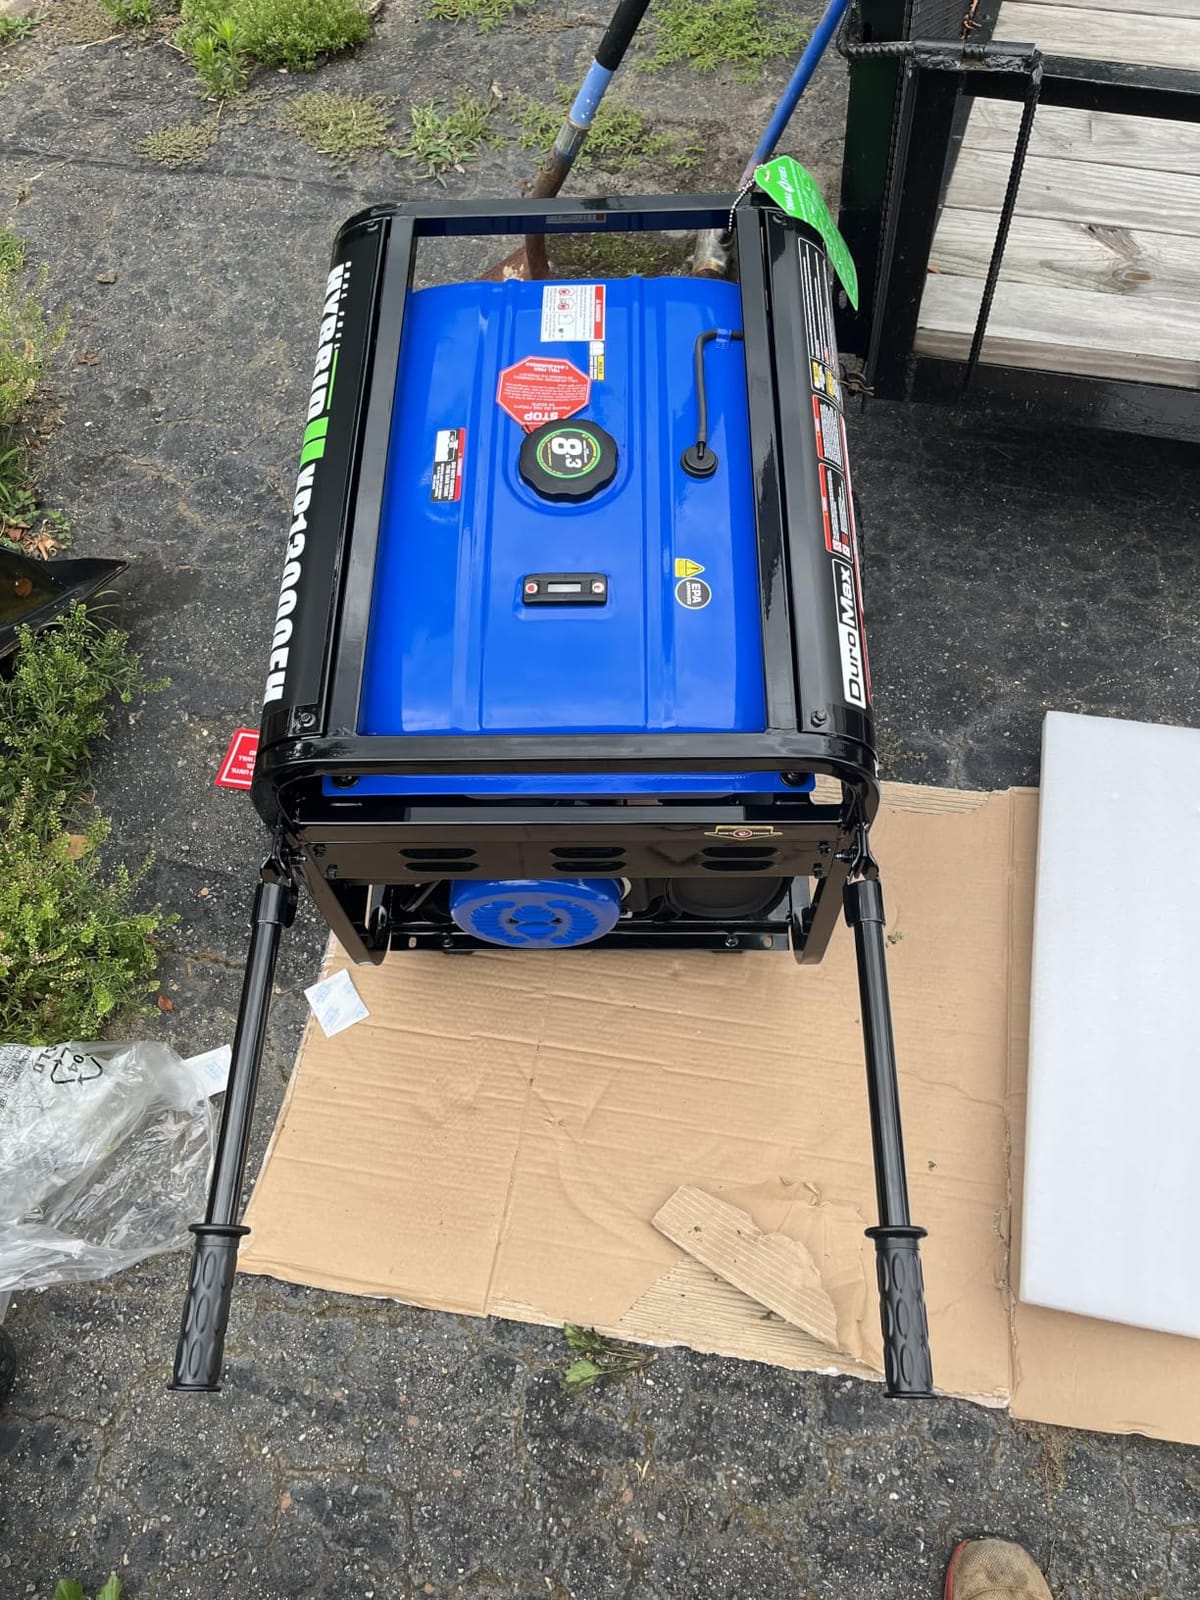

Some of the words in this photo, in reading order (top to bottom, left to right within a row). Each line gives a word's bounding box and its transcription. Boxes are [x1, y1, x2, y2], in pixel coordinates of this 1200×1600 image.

[341, 261, 352, 299] DUAL
[307, 263, 345, 422] HYBRID
[523, 411, 559, 421] STOP
[551, 437, 582, 468] 8.3
[691, 583, 702, 604] EPA
[840, 565, 862, 702] DuroMax
